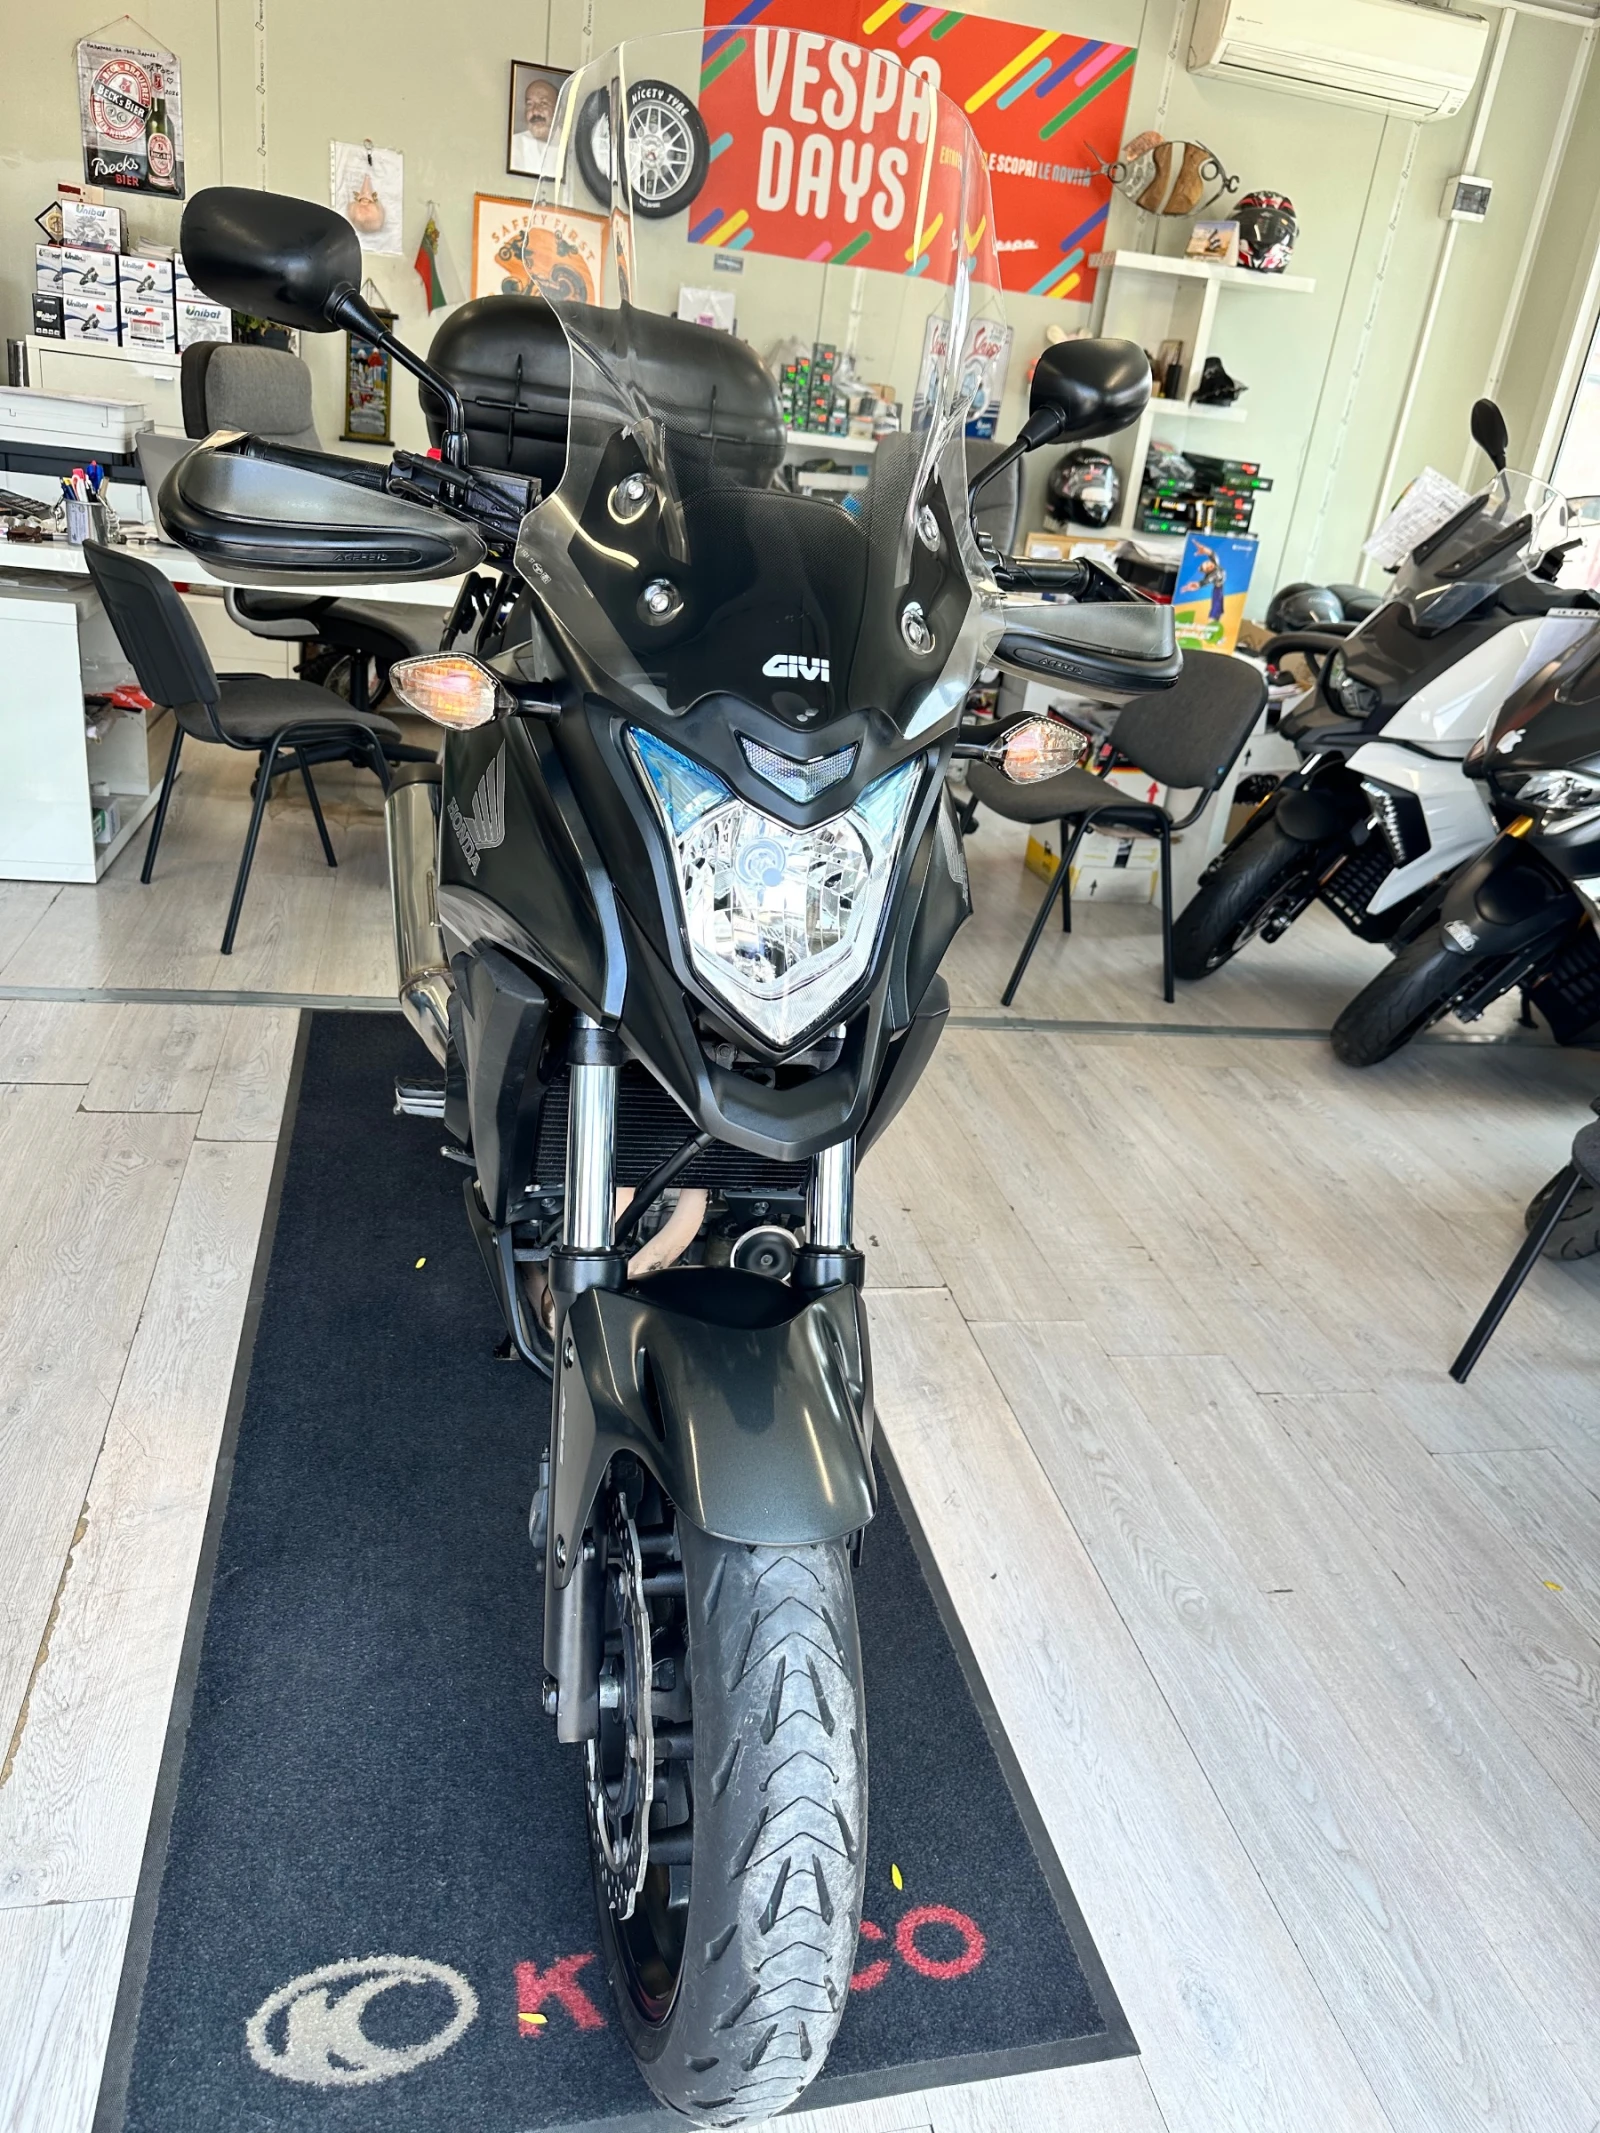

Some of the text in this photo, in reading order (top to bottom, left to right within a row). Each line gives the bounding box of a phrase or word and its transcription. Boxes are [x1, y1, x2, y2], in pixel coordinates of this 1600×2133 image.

[754, 27, 942, 145] VESPA
[124, 99, 145, 118] BIER
[666, 93, 690, 117] TYRE
[91, 155, 139, 177] Beck's
[757, 126, 909, 231] DAYS
[996, 154, 1038, 178] SCOPRI
[1037, 162, 1052, 180] LE
[115, 173, 140, 187] BIER
[76, 204, 106, 217] Unibat
[554, 218, 596, 261] FIRST
[185, 305, 221, 319] Unibat
[762, 654, 830, 683] GIVI
[446, 796, 481, 877] HONDA
